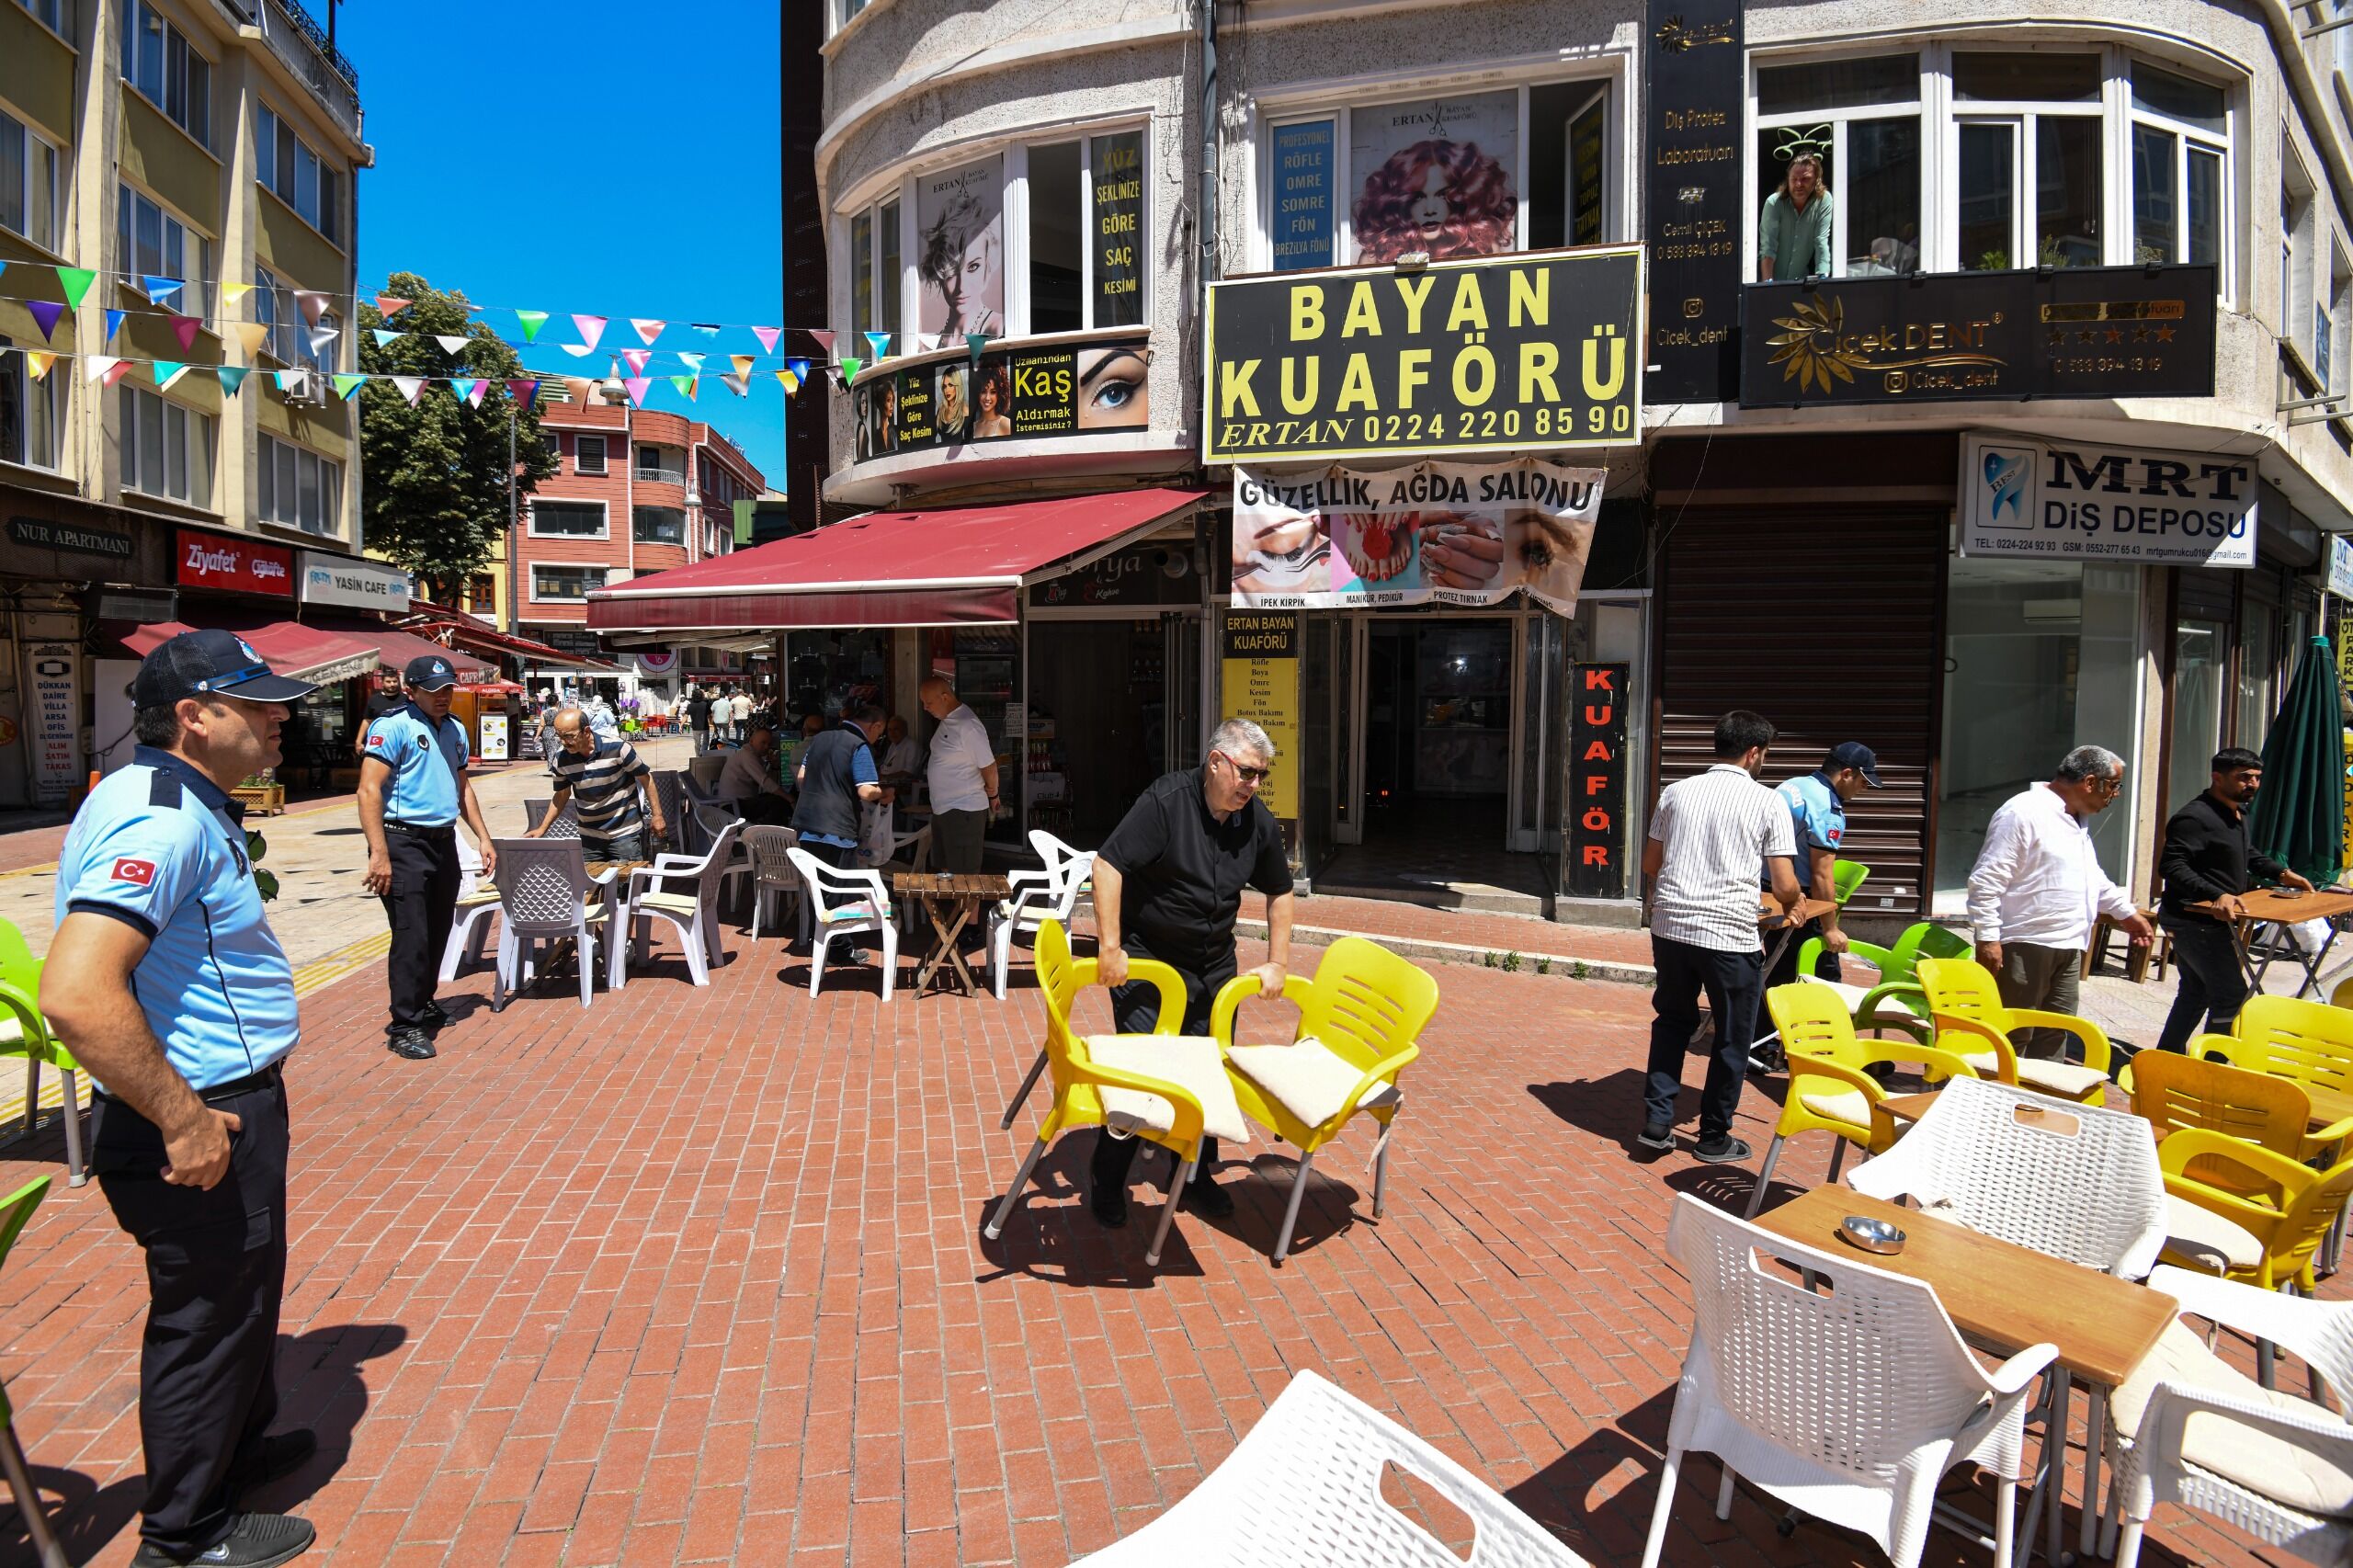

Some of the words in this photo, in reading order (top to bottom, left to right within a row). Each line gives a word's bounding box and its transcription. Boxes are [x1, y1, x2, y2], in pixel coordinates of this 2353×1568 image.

[1392, 113, 1434, 127] ERTAN
[1103, 148, 1135, 170] YÜZ
[1284, 151, 1324, 169] RÖFLE
[933, 177, 961, 194] ERTAN
[1287, 174, 1324, 191] OMRE
[1097, 179, 1141, 206] ŞEKLİNİZE
[1281, 195, 1325, 212] SOMRE
[1102, 213, 1136, 234] GÖRE
[1291, 215, 1316, 233] FÖN
[1106, 246, 1132, 267] SAÇ
[1656, 245, 1664, 260] 0
[1104, 277, 1137, 295] KESİMİ
[1290, 267, 1551, 342] BAYAN
[1808, 324, 1898, 355] Cicek
[1904, 321, 1990, 350] DENT
[1015, 354, 1072, 367] Uzmanından
[1220, 324, 1626, 418] KUAFÖRÜ
[1912, 369, 1999, 390] Cicek_dent
[908, 377, 920, 390] Yüz
[1015, 368, 1072, 403] Kaş
[901, 393, 928, 411] Şeklinize
[907, 411, 922, 424] Göre
[1016, 406, 1072, 422] Aldırmak
[900, 429, 912, 443] Saç
[912, 426, 932, 439] Kesim
[1216, 418, 1355, 449] ERTAN
[1363, 414, 1445, 443] 0224
[1459, 409, 1520, 438] 220
[1534, 407, 1574, 436] 85
[1587, 404, 1631, 434] 90
[1989, 470, 2018, 494] BEST
[2046, 450, 2248, 501] MRT
[1240, 471, 1381, 511] GÜZELLİK,
[1390, 469, 1471, 506] AĞDA
[1479, 472, 1596, 511] SALONU
[2113, 505, 2247, 540] DEPOSU
[17, 523, 50, 542] NUR
[54, 530, 131, 554] APARTMANI
[1974, 538, 1995, 549] TEL:
[1996, 539, 2034, 551] 0224-224
[2034, 540, 2045, 551] 92
[2046, 540, 2057, 551] 93
[2063, 542, 2085, 552] GSM:
[2086, 542, 2120, 554] 0552-277
[2120, 544, 2131, 555] 65
[2131, 544, 2142, 556] 43
[187, 544, 236, 575] Ziyafet
[335, 575, 363, 592] YASİN
[364, 581, 387, 596] CAFE
[1260, 596, 1279, 608] İPEK
[1279, 596, 1306, 608] KİRPİK
[1433, 590, 1459, 602] PROTEZ
[1460, 593, 1488, 605] TIRNAK
[1227, 618, 1259, 631] ERTAN
[1261, 616, 1294, 631] BAYAN
[1233, 631, 1288, 650] KUAFÖRÜ
[1251, 657, 1269, 666] Röfle
[460, 672, 479, 684] CAFE
[1251, 668, 1268, 678] Boya
[38, 681, 72, 690] DÜKKAN
[1249, 688, 1271, 697] Kesim
[42, 691, 67, 700] DAİRE
[1253, 699, 1267, 707] Fön
[43, 701, 67, 710] VİLLA
[1237, 709, 1256, 717] Botox
[1258, 709, 1284, 717] Bakımı
[45, 712, 67, 721] ARSA
[1262, 719, 1286, 727] Bakım
[47, 722, 65, 731] OFİS
[49, 743, 67, 751] ALIM
[1582, 670, 1614, 866] KUAFÖR
